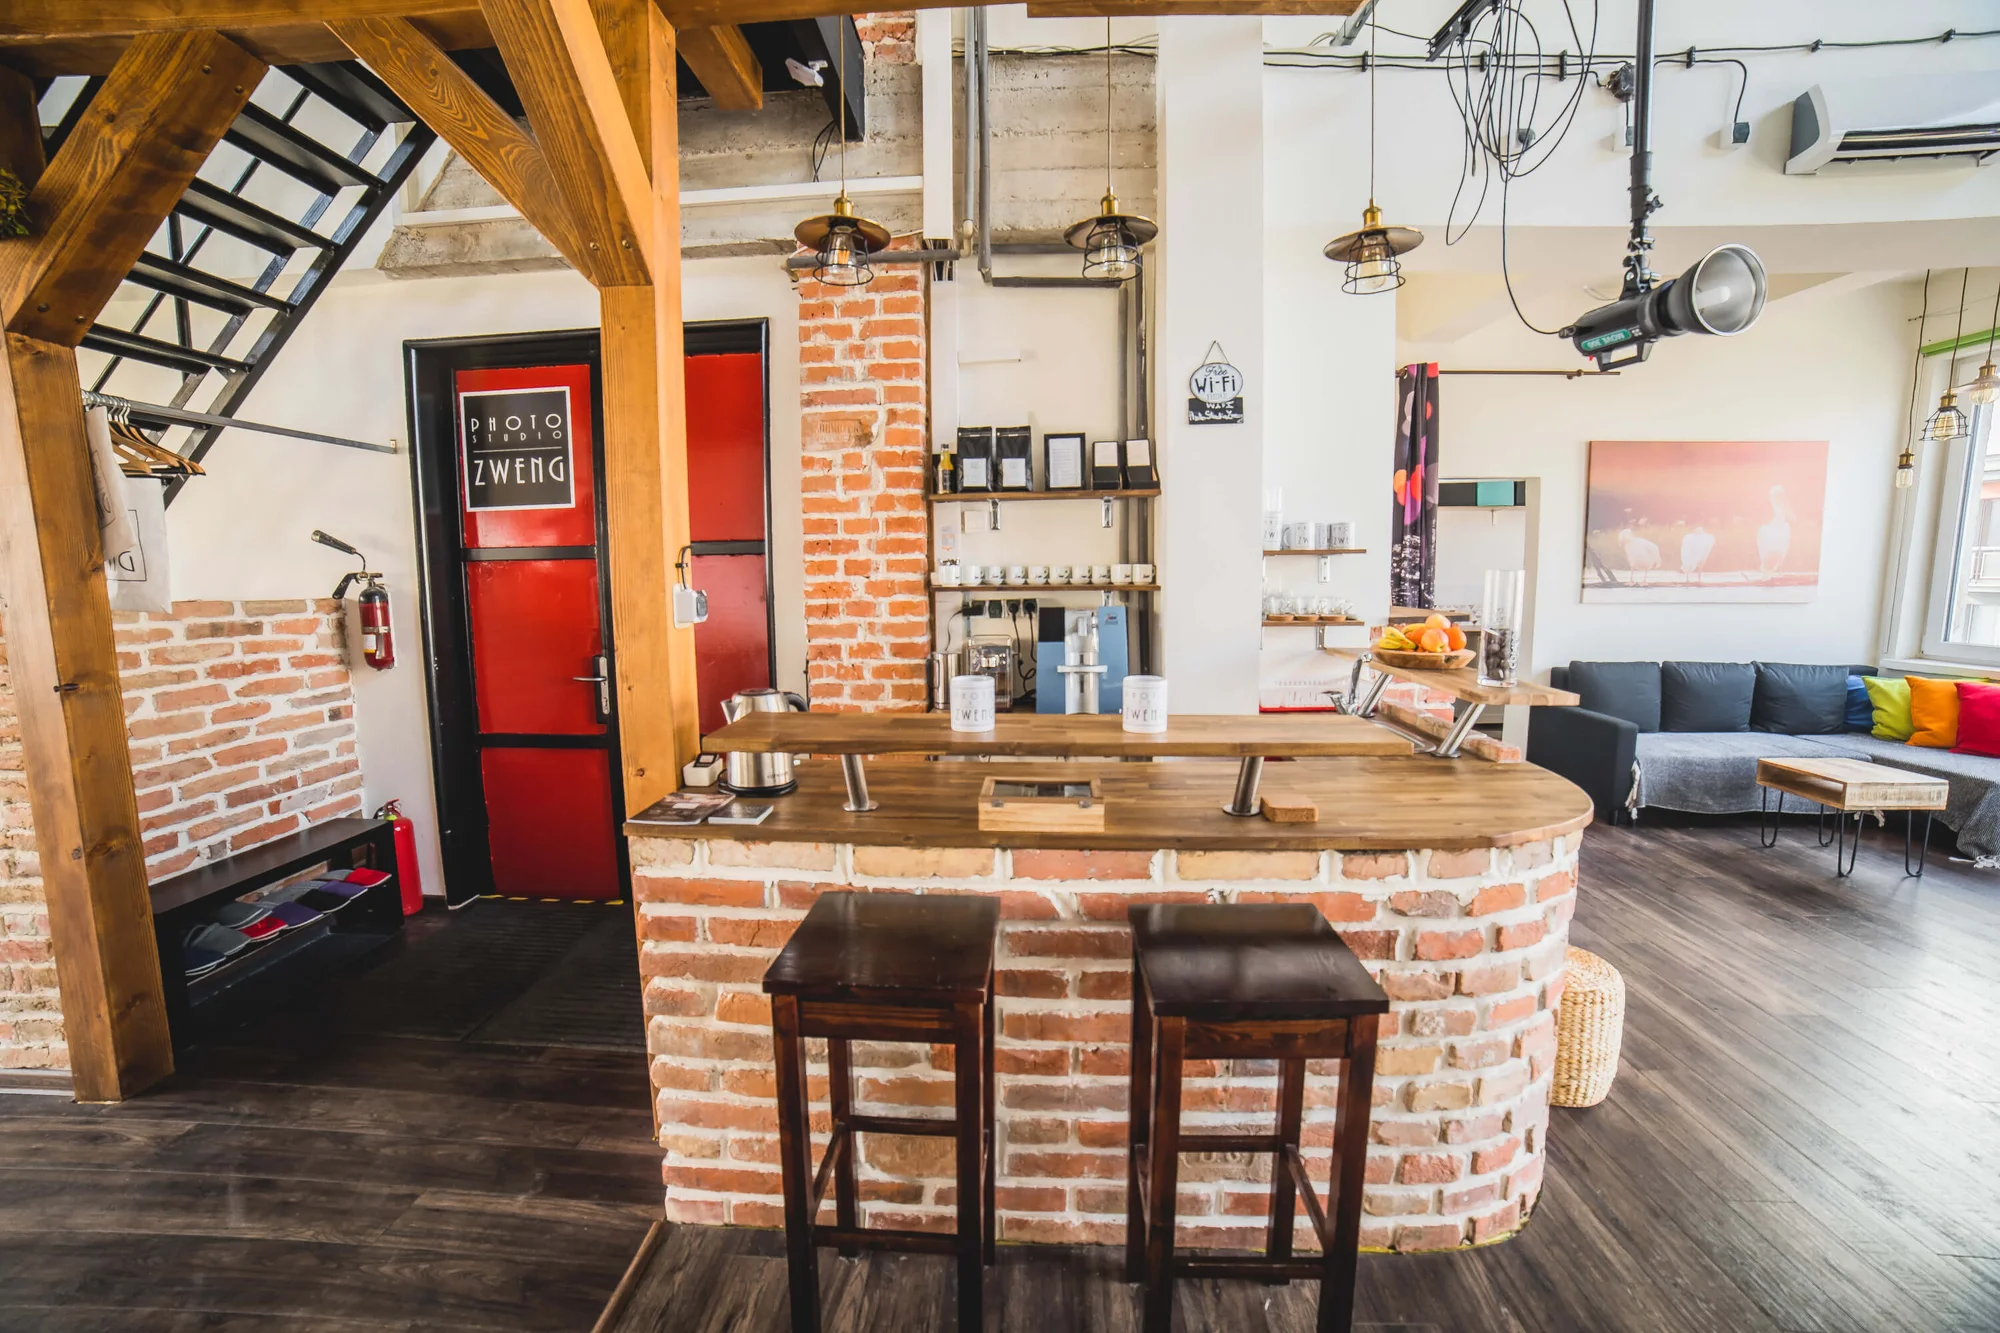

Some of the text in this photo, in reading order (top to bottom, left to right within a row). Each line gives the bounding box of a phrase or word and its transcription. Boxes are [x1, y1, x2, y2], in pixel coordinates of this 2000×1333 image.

[1204, 365, 1228, 377] Free
[1194, 375, 1236, 393] Wi-Fi
[471, 413, 562, 432] PHOTO
[472, 430, 562, 443] STUDIO
[474, 456, 564, 486] ZWENG
